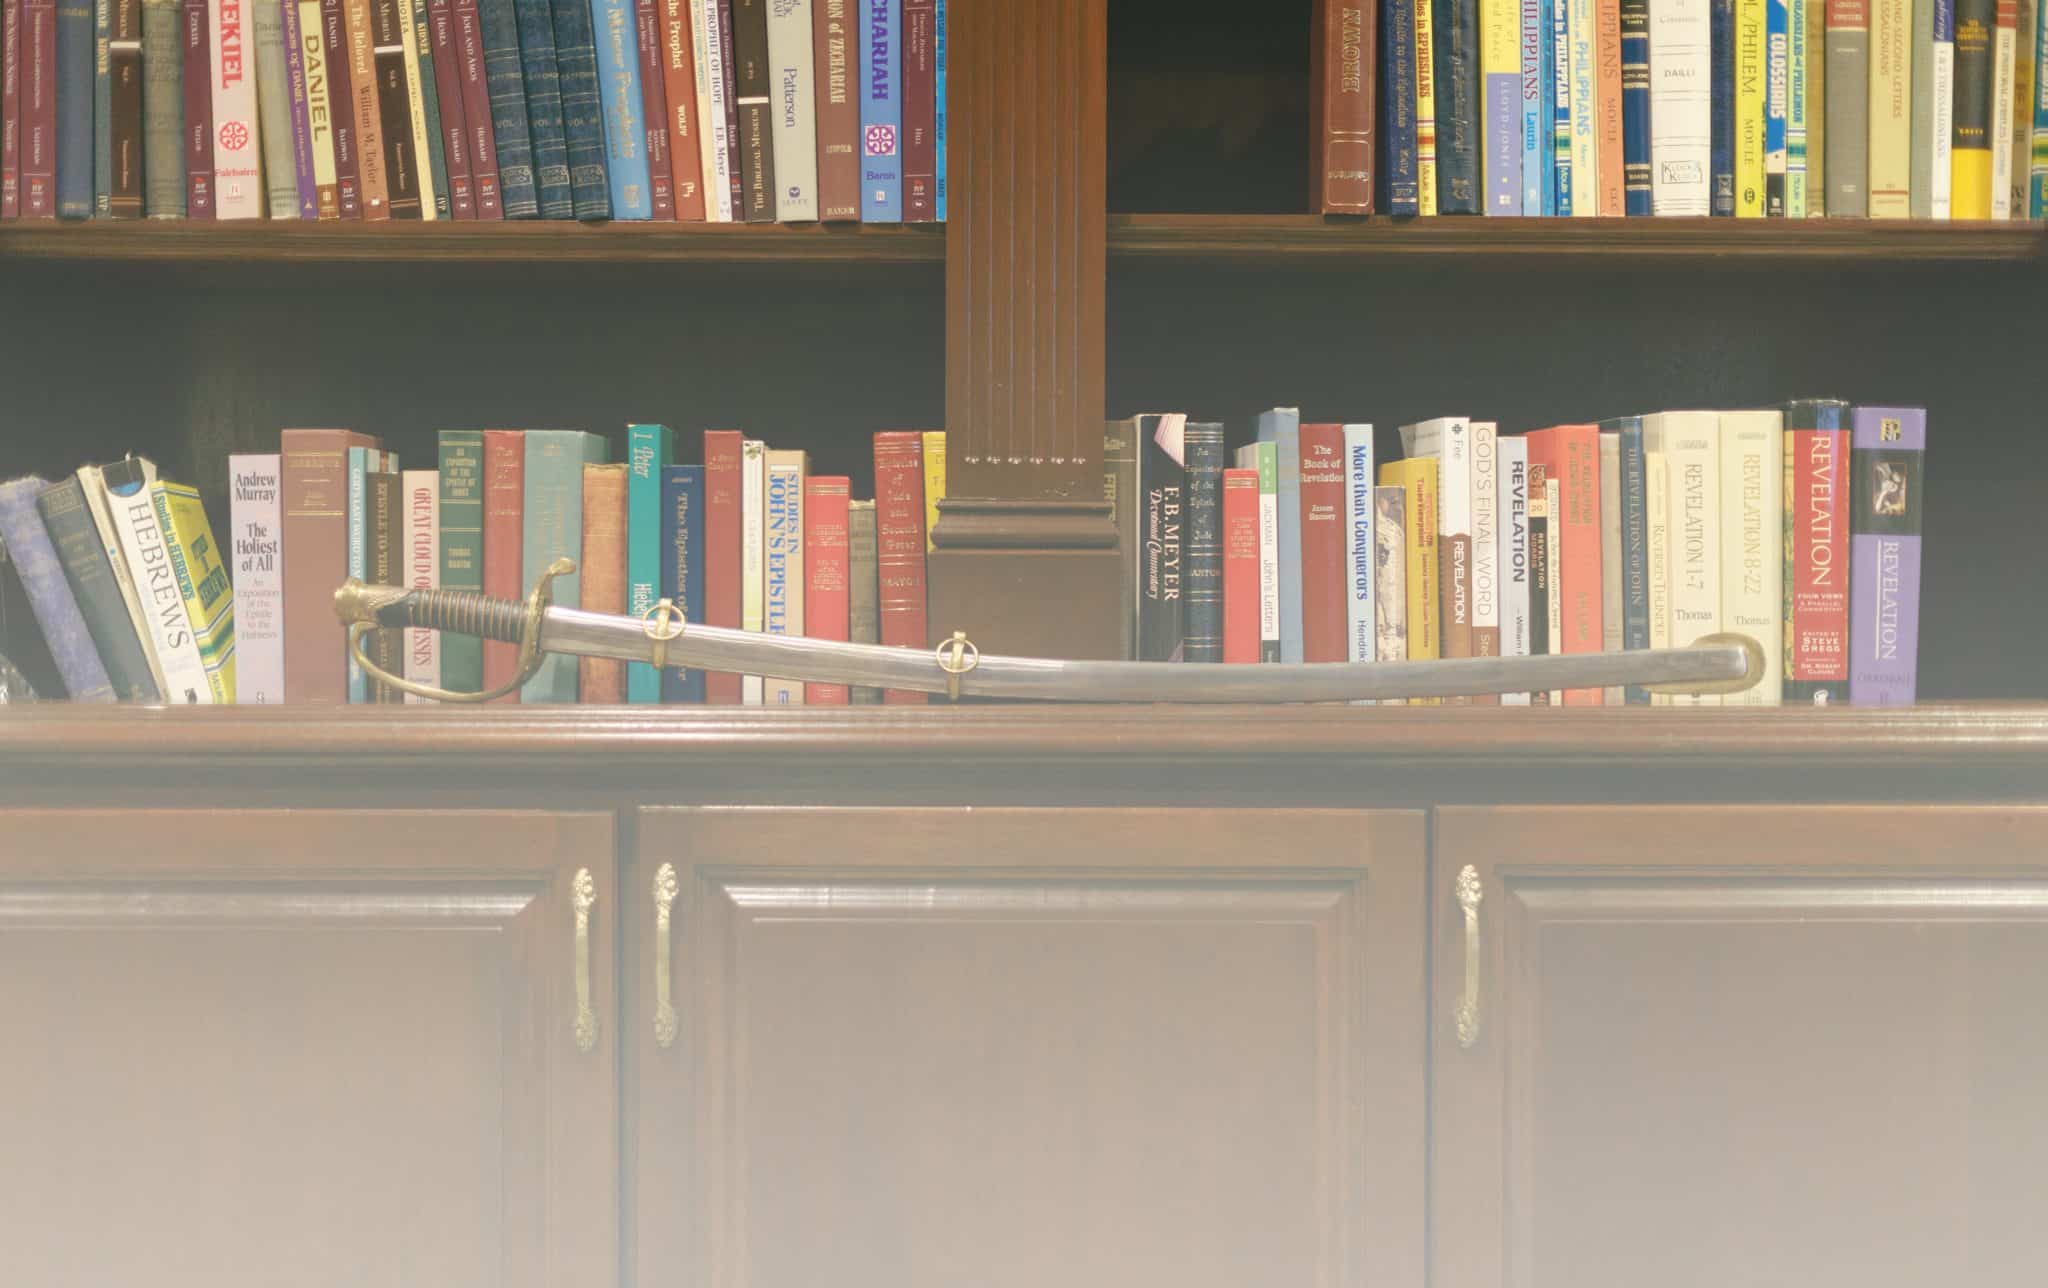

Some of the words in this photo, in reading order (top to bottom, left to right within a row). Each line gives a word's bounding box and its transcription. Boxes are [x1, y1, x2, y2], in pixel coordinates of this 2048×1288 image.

[220, 0, 241, 88] EKIEL
[668, 20, 684, 69] Prophet
[706, 8, 721, 57] PROPHET
[1342, 8, 1360, 93] BROWN
[1602, 0, 1617, 79] IPPIANS
[1880, 0, 1889, 76] ESSALONIANS
[305, 35, 327, 142] DANIEL
[829, 38, 846, 104] ZECHARIAH
[1418, 32, 1430, 98] EPHESIANS
[1575, 41, 1590, 136] PHILIPPIANS
[359, 85, 371, 128] William
[783, 68, 798, 128] Patterson
[1607, 97, 1617, 145] MOULE
[1526, 112, 1538, 150] Laurin
[1744, 118, 1755, 168] MOULE
[633, 432, 653, 440] 1
[633, 446, 654, 478] Peter
[1304, 459, 1328, 469] Book
[1331, 459, 1341, 468] of
[1312, 445, 1332, 455] The
[1352, 445, 1367, 480] More
[1475, 427, 1492, 490] GOD'S
[235, 472, 275, 487] Andrew
[236, 487, 276, 504] Murray
[787, 473, 799, 533] STUDIES
[1353, 484, 1367, 517] than
[1743, 453, 1761, 555] REVELATION
[246, 523, 267, 538] The
[412, 487, 433, 529] GREAT
[768, 473, 786, 549] JOHN'S
[1477, 496, 1492, 552] FINAL
[1511, 460, 1525, 583] REVELATION
[1629, 473, 1641, 552] REVELATION
[1685, 463, 1703, 563] REVELATION
[1810, 435, 1832, 586] REVELATION
[236, 539, 277, 555] Holiest
[241, 556, 254, 572] of
[255, 556, 273, 572] All
[412, 533, 433, 574] CLOUD
[788, 538, 800, 554] IN
[1146, 540, 1162, 600] Commentary
[1164, 524, 1179, 601] MEYER
[1352, 521, 1369, 601] Conquerors
[1537, 533, 1545, 589] REVELATION
[128, 502, 189, 649] HEBREWS
[631, 583, 652, 616] Hieber
[769, 554, 785, 635] EPISTLE
[1454, 541, 1465, 624] REVELATION
[1477, 554, 1493, 616] WORD
[1631, 570, 1642, 606] JOHN
[1744, 558, 1762, 595] 8-22
[1881, 540, 1899, 660] REVELATION
[1264, 594, 1276, 633] Letters
[1357, 619, 1368, 664] Hendrik
[1674, 609, 1712, 622] Thomas
